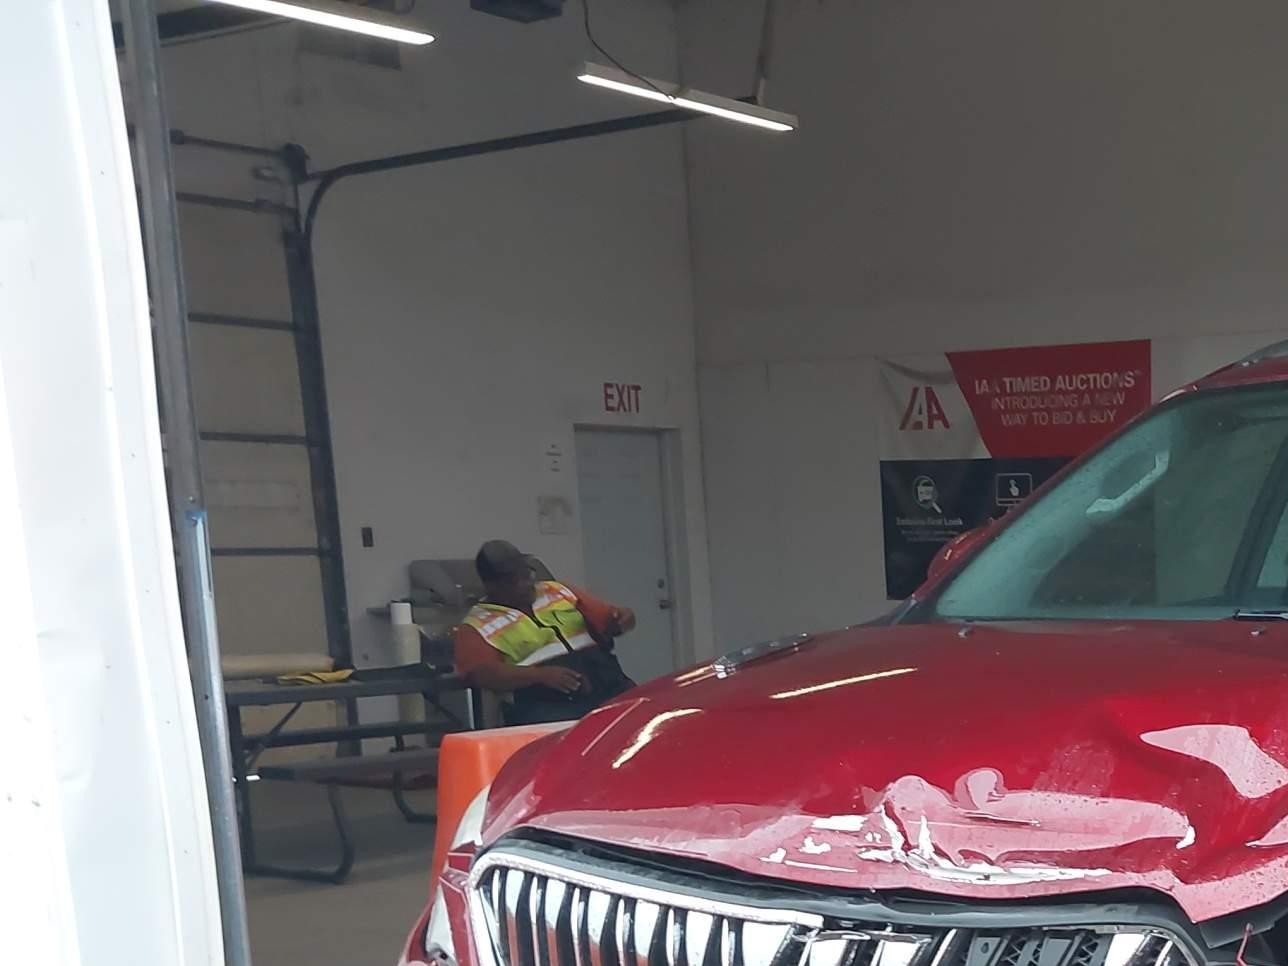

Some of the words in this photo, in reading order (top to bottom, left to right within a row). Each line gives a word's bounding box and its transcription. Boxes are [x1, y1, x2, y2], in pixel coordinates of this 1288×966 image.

[1003, 376, 1051, 393] TIMED
[603, 382, 642, 414] EXIT
[991, 393, 1079, 411] INTRODUCING
[1082, 393, 1092, 407] A
[1094, 391, 1126, 407] NEW
[1000, 412, 1029, 427] WAY
[1032, 411, 1049, 425] TO
[1052, 410, 1073, 425] BID
[1075, 410, 1087, 424] &
[1090, 408, 1117, 424] BUY
